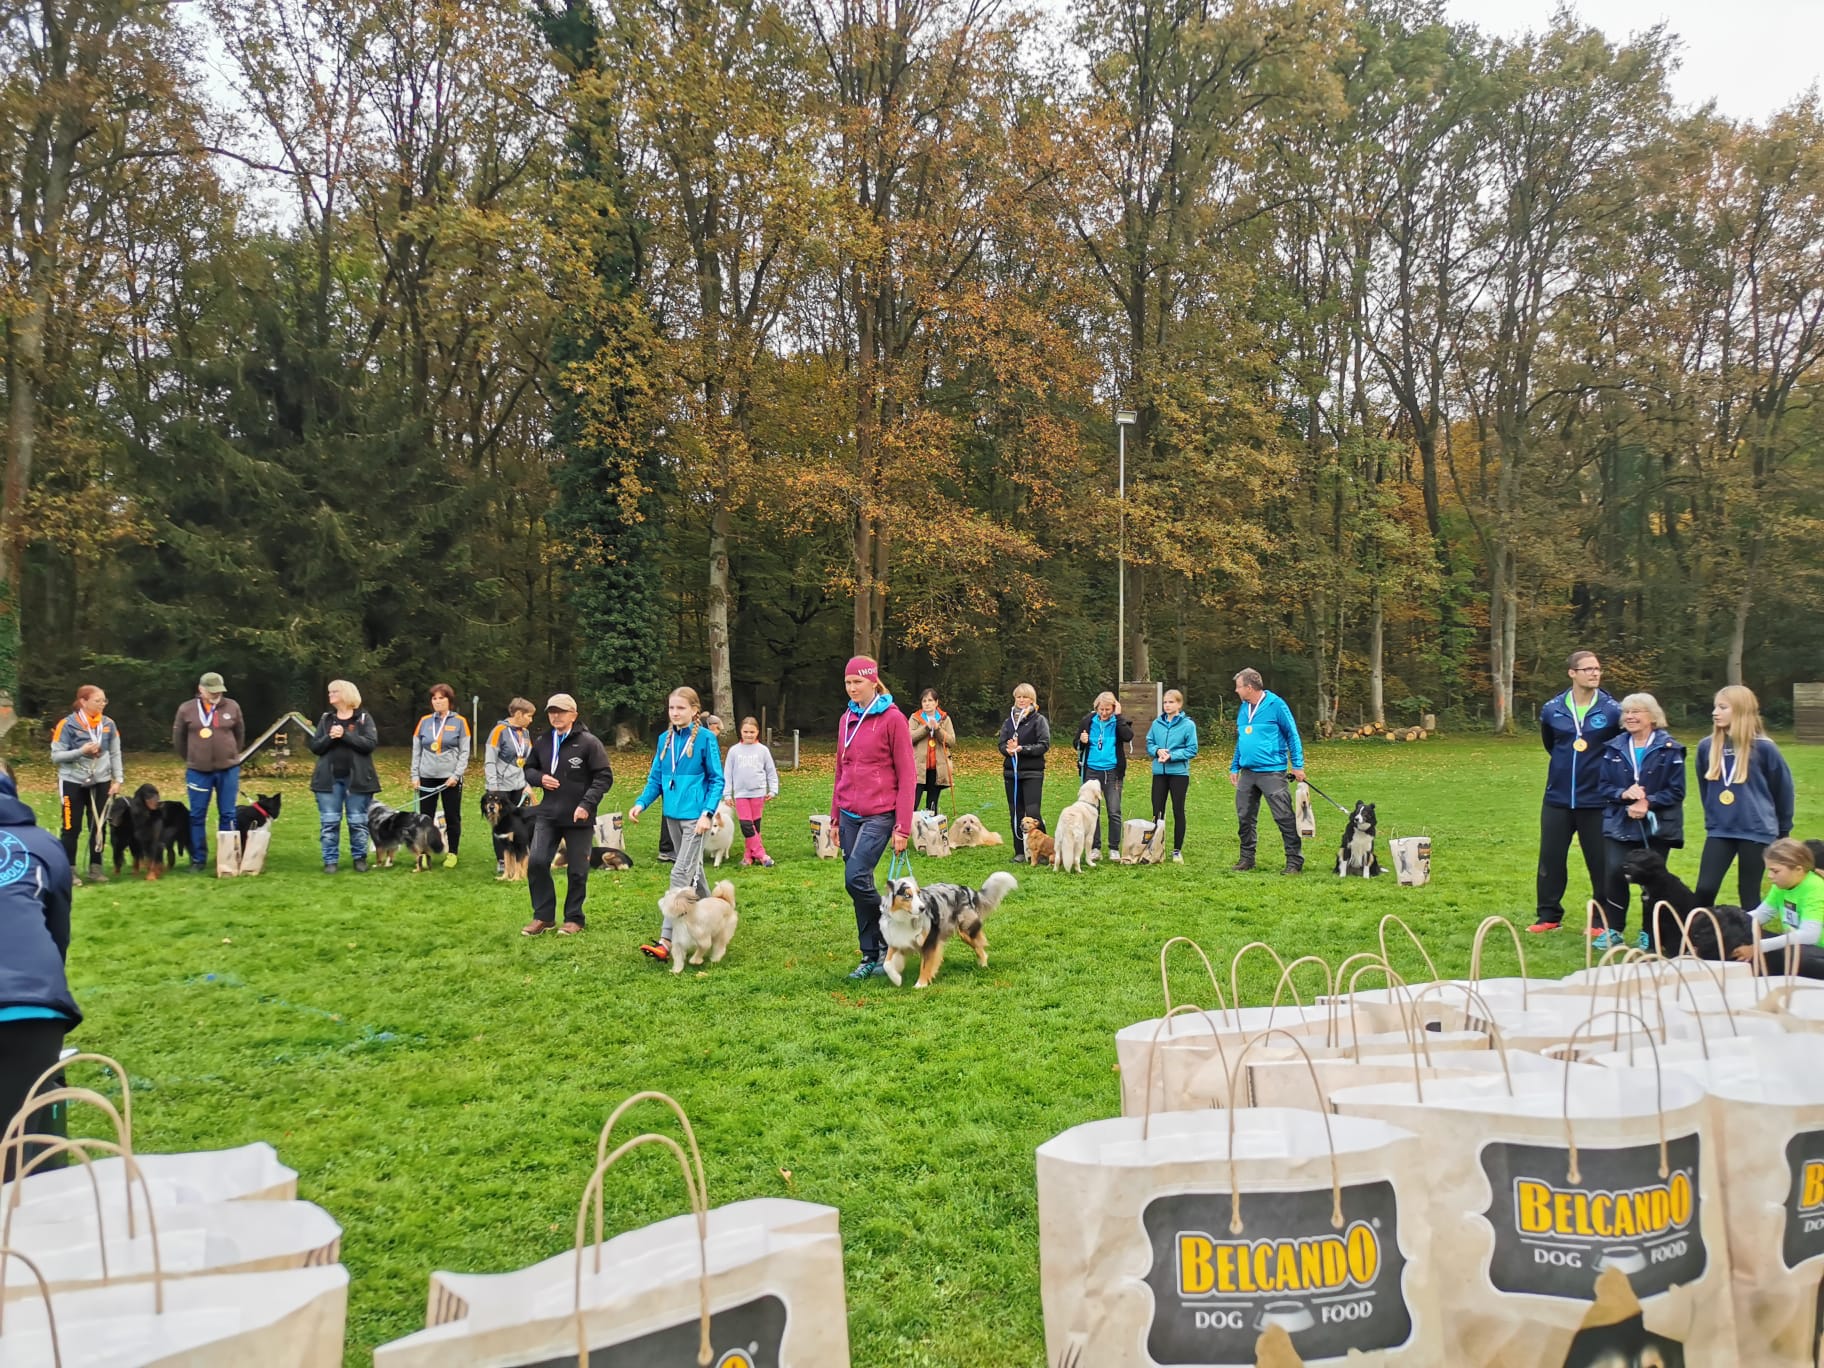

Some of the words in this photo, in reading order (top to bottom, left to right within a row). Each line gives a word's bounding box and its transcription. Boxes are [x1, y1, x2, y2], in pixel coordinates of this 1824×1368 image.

[1516, 1172, 1692, 1239] BELCANDO
[1177, 1222, 1380, 1296] BELCANDO
[1534, 1248, 1582, 1268] DOG
[1651, 1240, 1688, 1264] FOOD
[1195, 1311, 1243, 1329] DOG
[1321, 1301, 1373, 1324] FOOD
